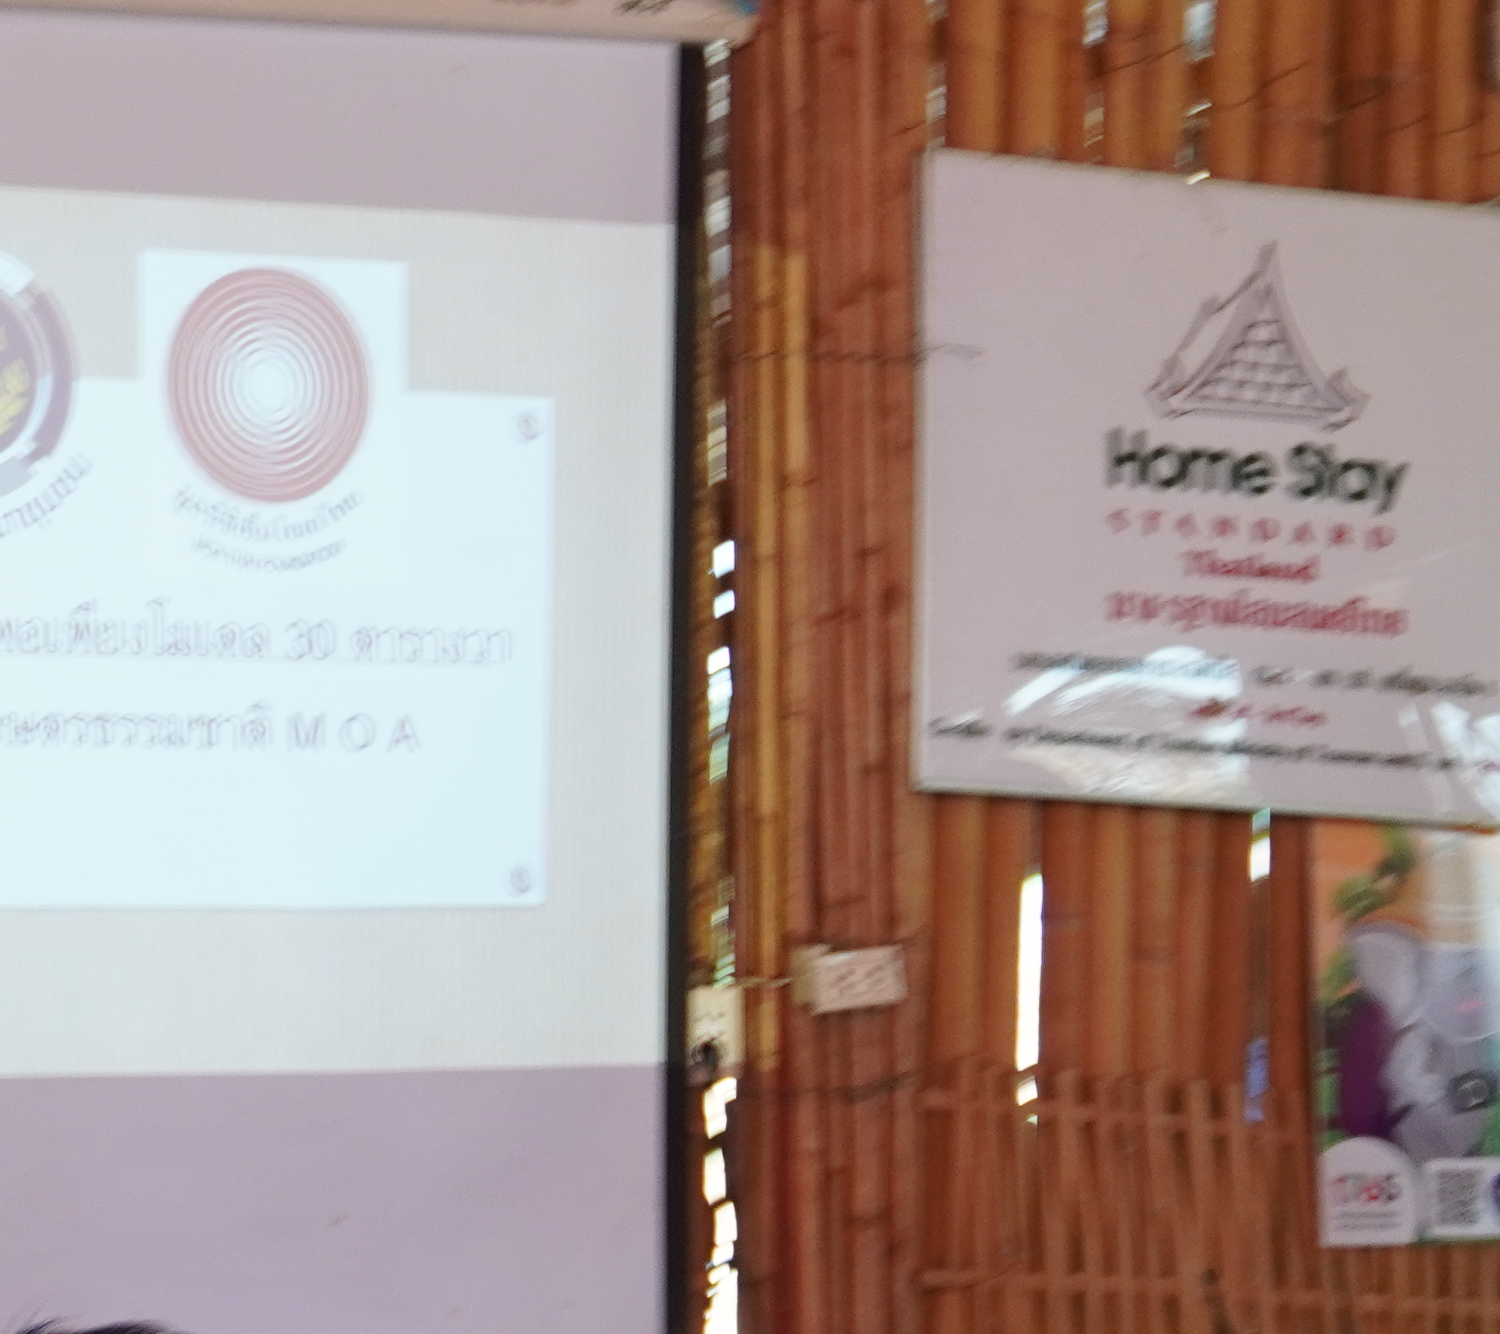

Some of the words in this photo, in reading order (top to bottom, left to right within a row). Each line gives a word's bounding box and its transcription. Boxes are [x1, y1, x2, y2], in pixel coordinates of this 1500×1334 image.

[1102, 427, 1276, 497] Home
[1285, 441, 1410, 515] Stay
[282, 616, 339, 661] 30
